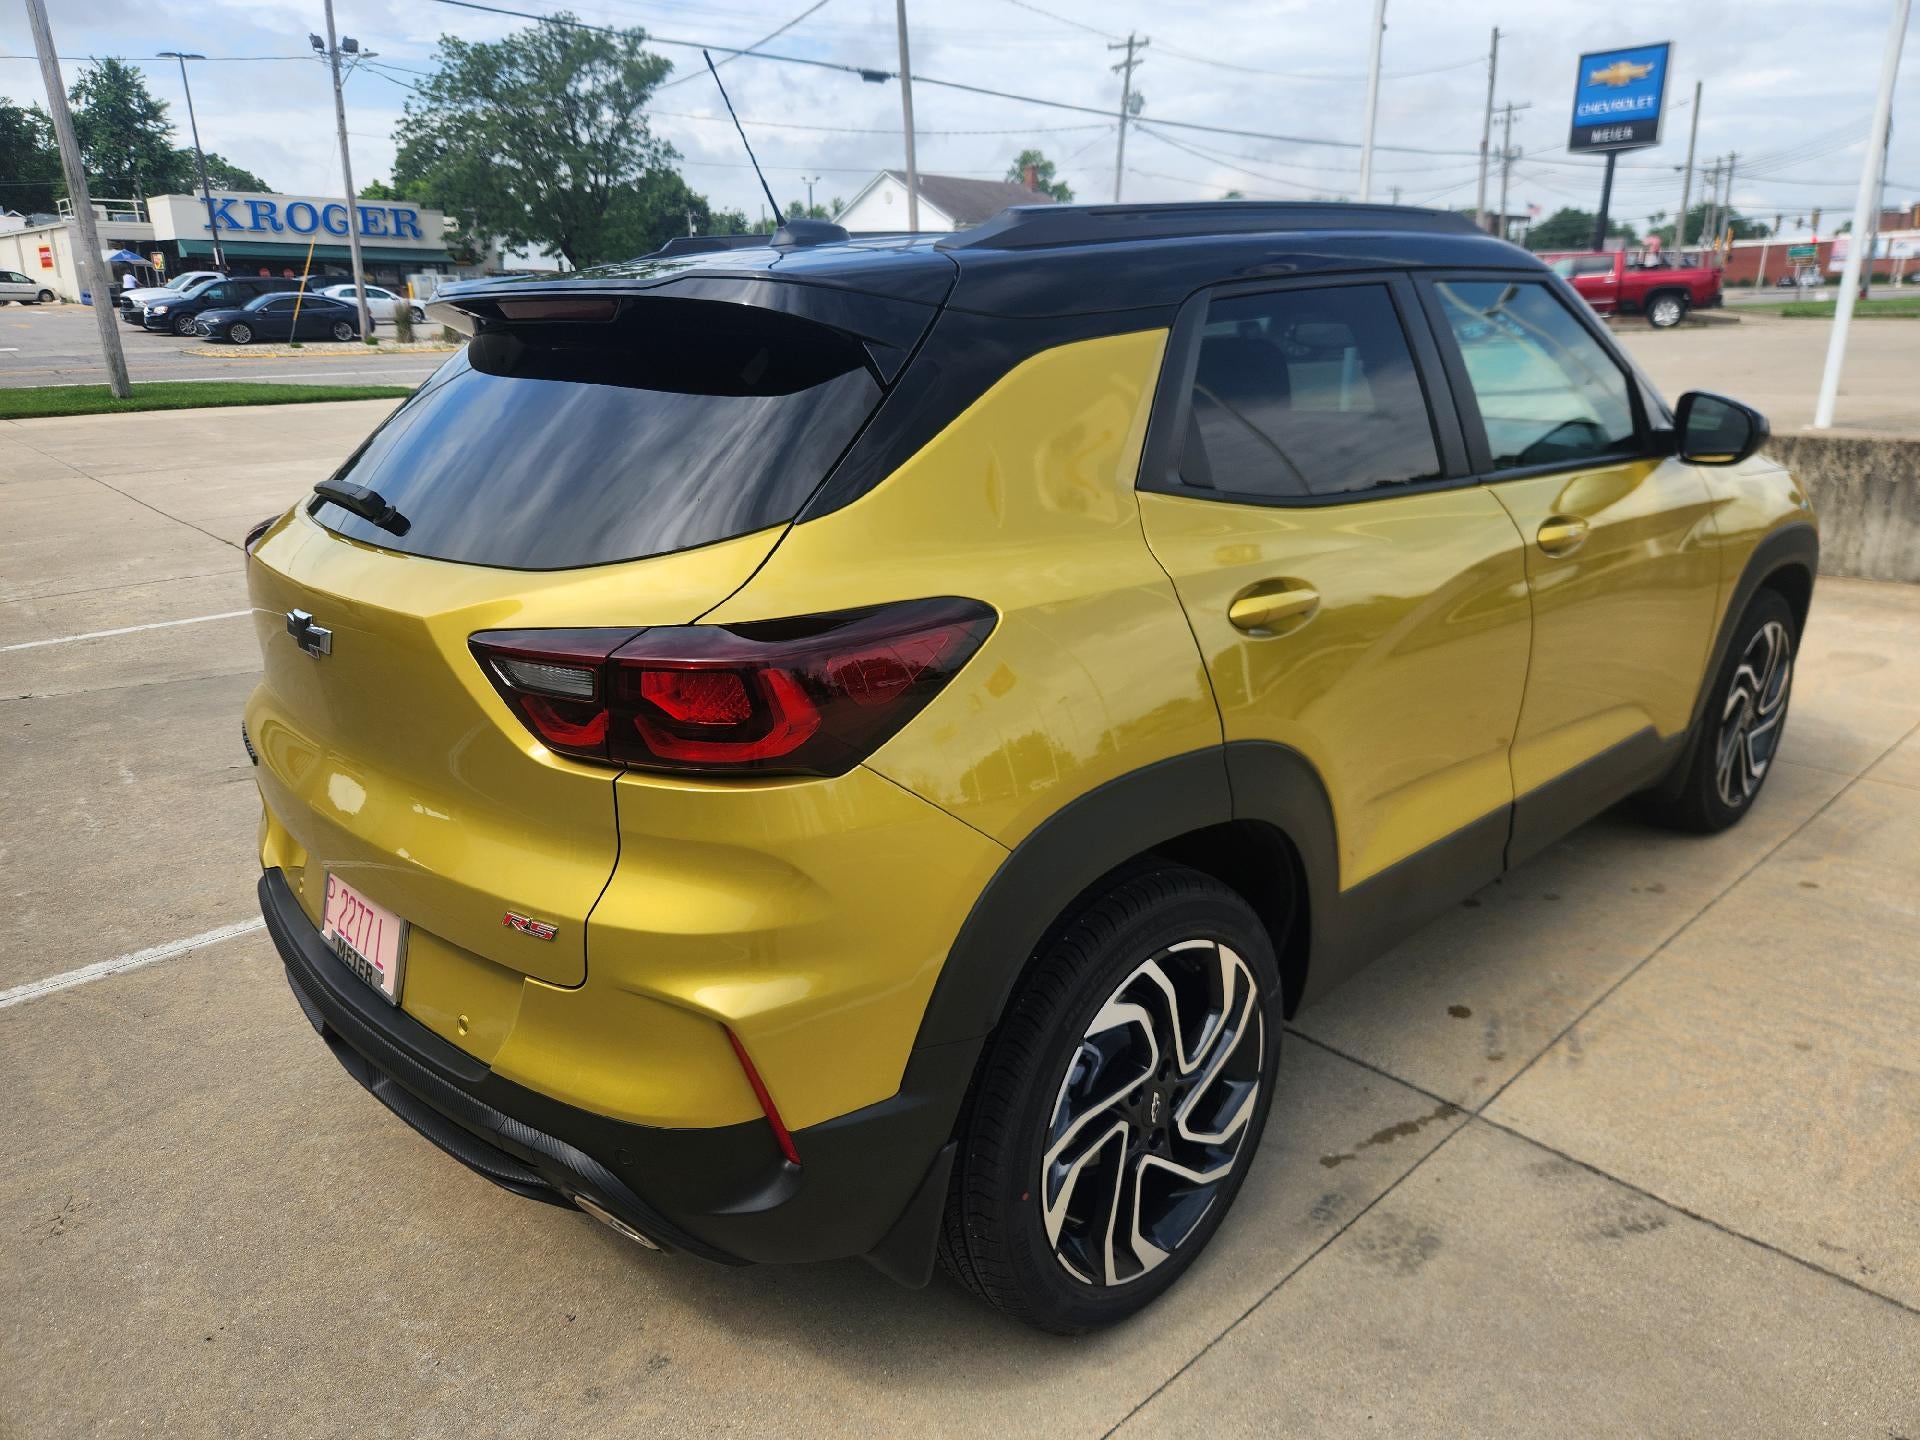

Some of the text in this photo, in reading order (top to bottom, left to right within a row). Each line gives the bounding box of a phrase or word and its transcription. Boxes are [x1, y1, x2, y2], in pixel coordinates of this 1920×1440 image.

[1577, 95, 1656, 116] CHEVROLET
[1591, 126, 1633, 143] MEIER
[200, 197, 422, 241] KROGER
[338, 888, 374, 956] 2277
[502, 911, 559, 941] RS
[336, 938, 373, 985] MEIER
